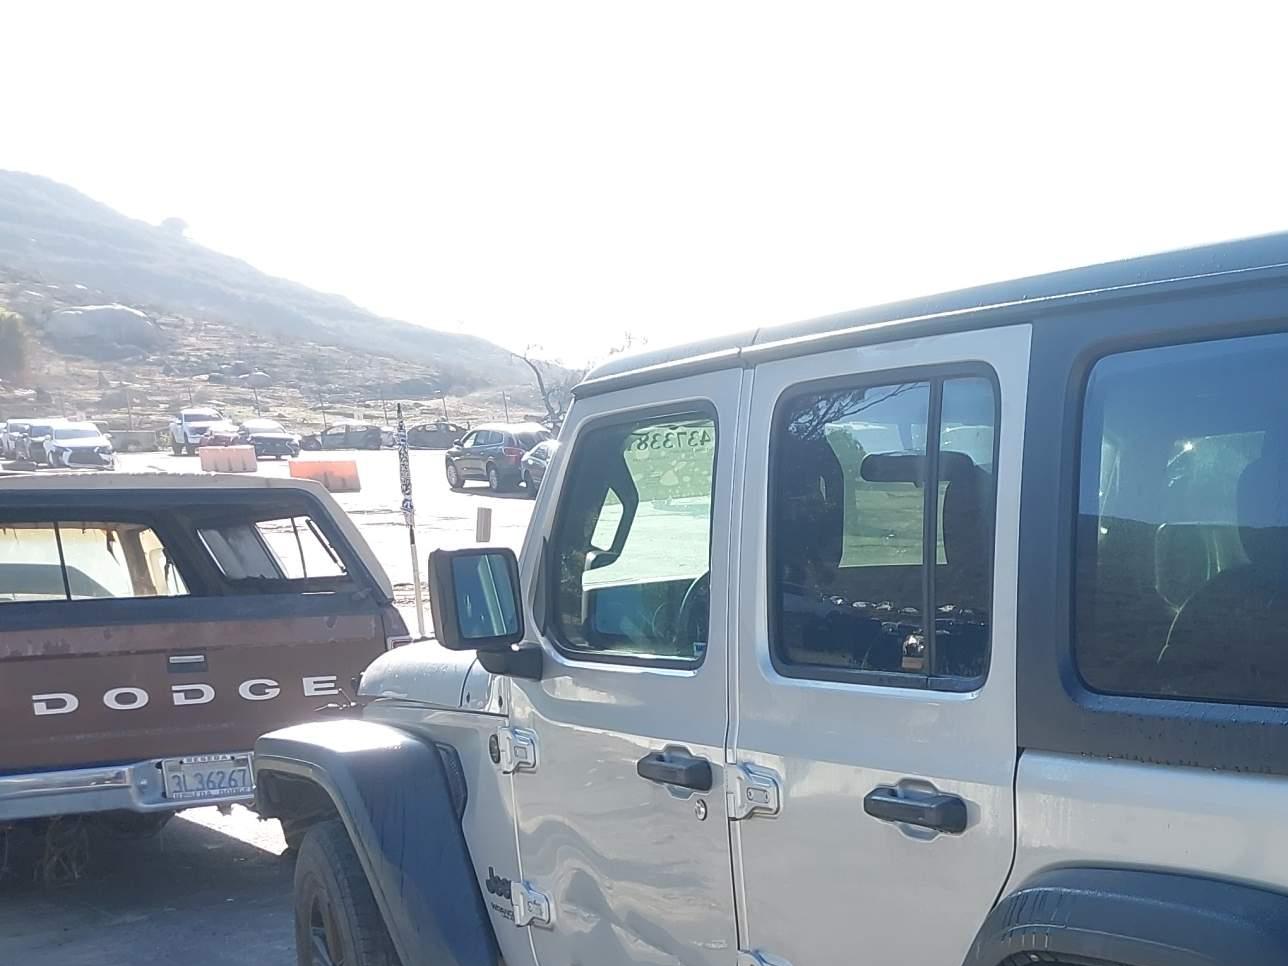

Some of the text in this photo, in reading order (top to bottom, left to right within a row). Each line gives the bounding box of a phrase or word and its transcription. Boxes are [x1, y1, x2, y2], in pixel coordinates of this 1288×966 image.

[32, 675, 339, 716] DODGE
[171, 770, 247, 793] 3L36267
[486, 866, 512, 899] Jee
